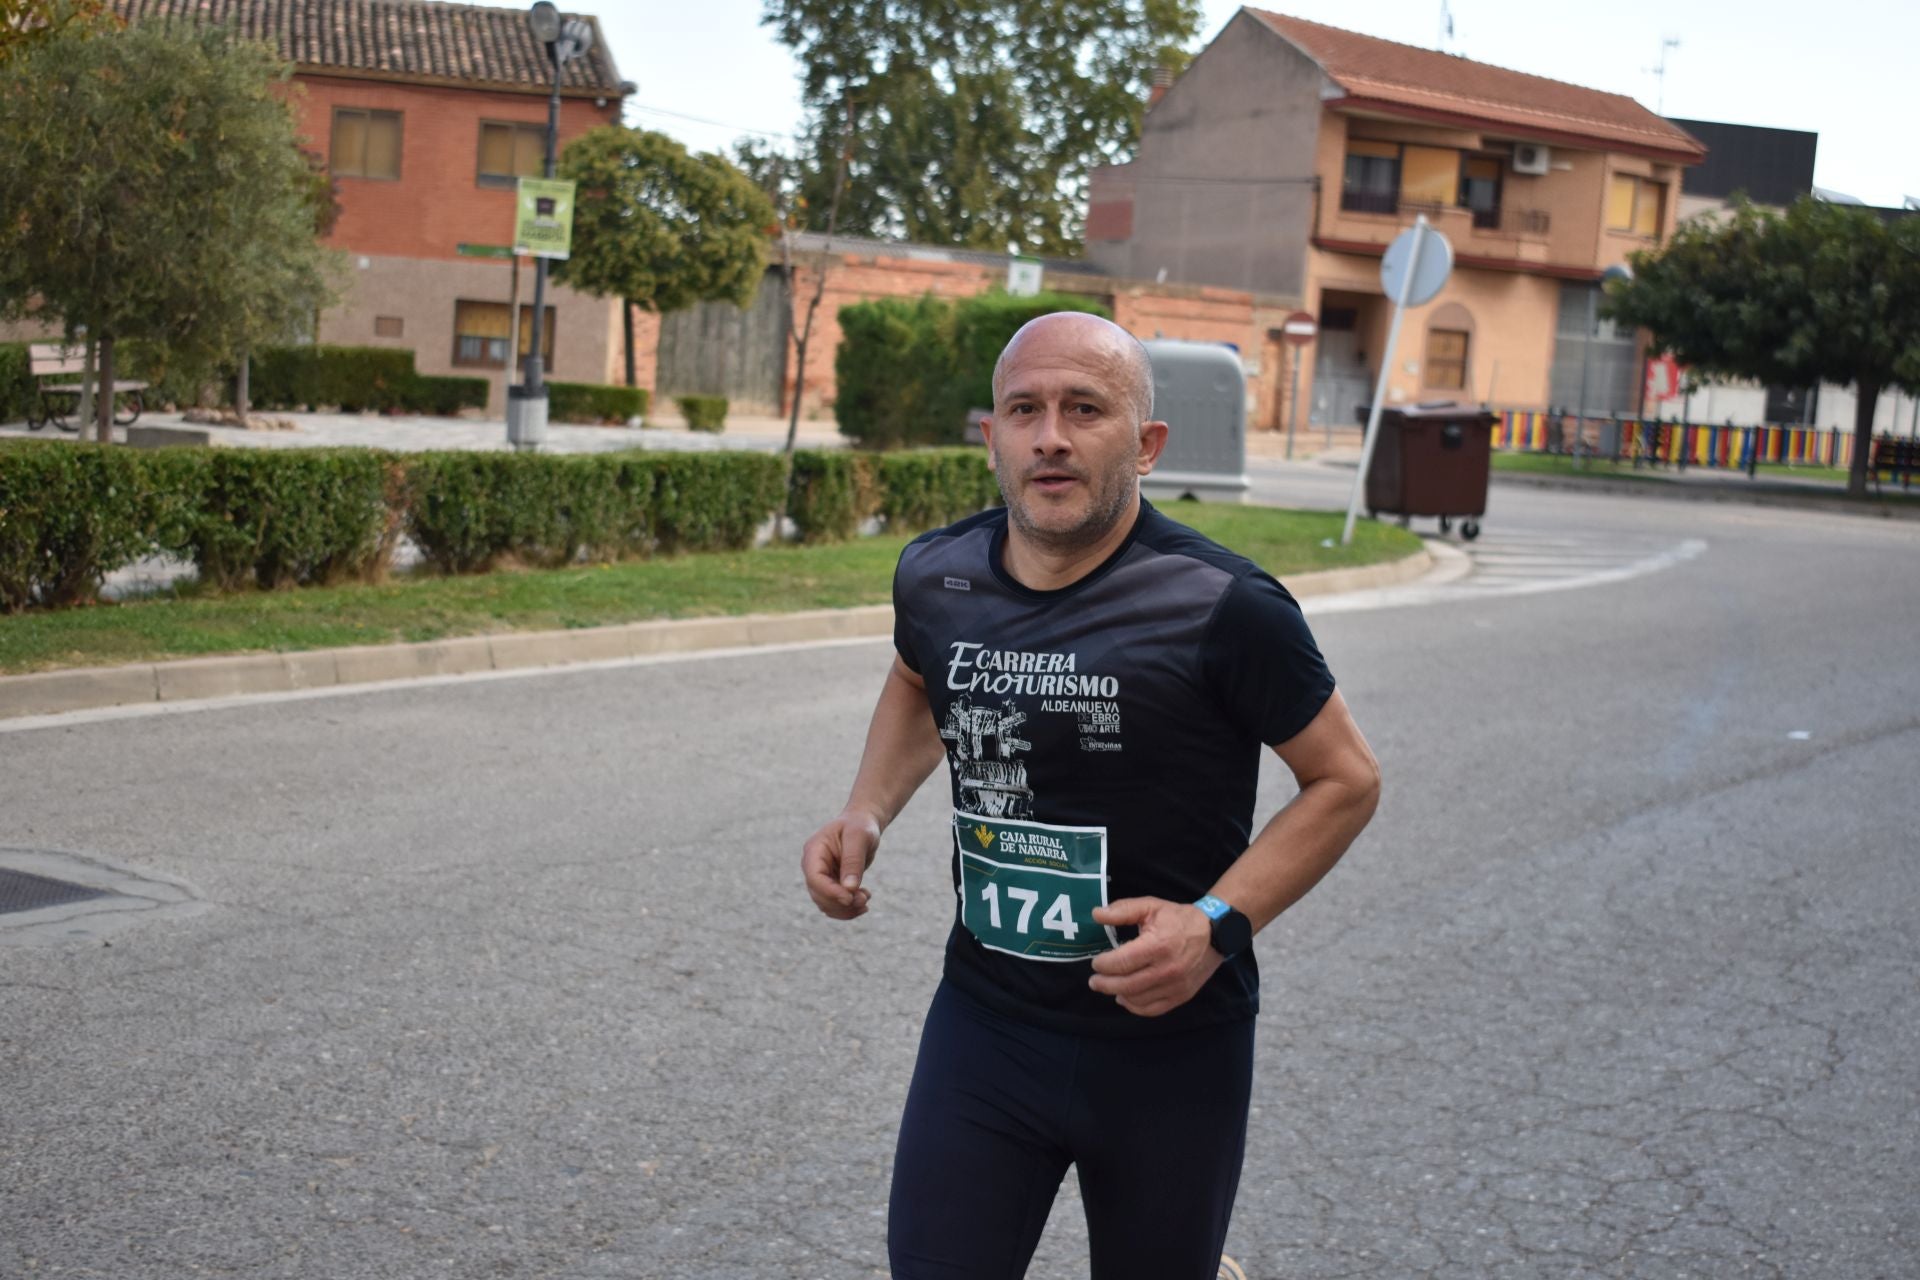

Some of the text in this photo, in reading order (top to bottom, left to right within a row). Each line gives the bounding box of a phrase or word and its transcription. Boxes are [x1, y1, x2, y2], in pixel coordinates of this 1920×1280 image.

[975, 649, 1076, 673] CARRERA
[1040, 700, 1120, 713] ALDEANUEVA
[1091, 713, 1121, 723] EBRO
[1099, 724, 1121, 733] ARTE
[999, 830, 1063, 849] CAJA RURAL
[1000, 841, 1068, 861] DE NAVARRA
[981, 881, 1079, 940] 174
